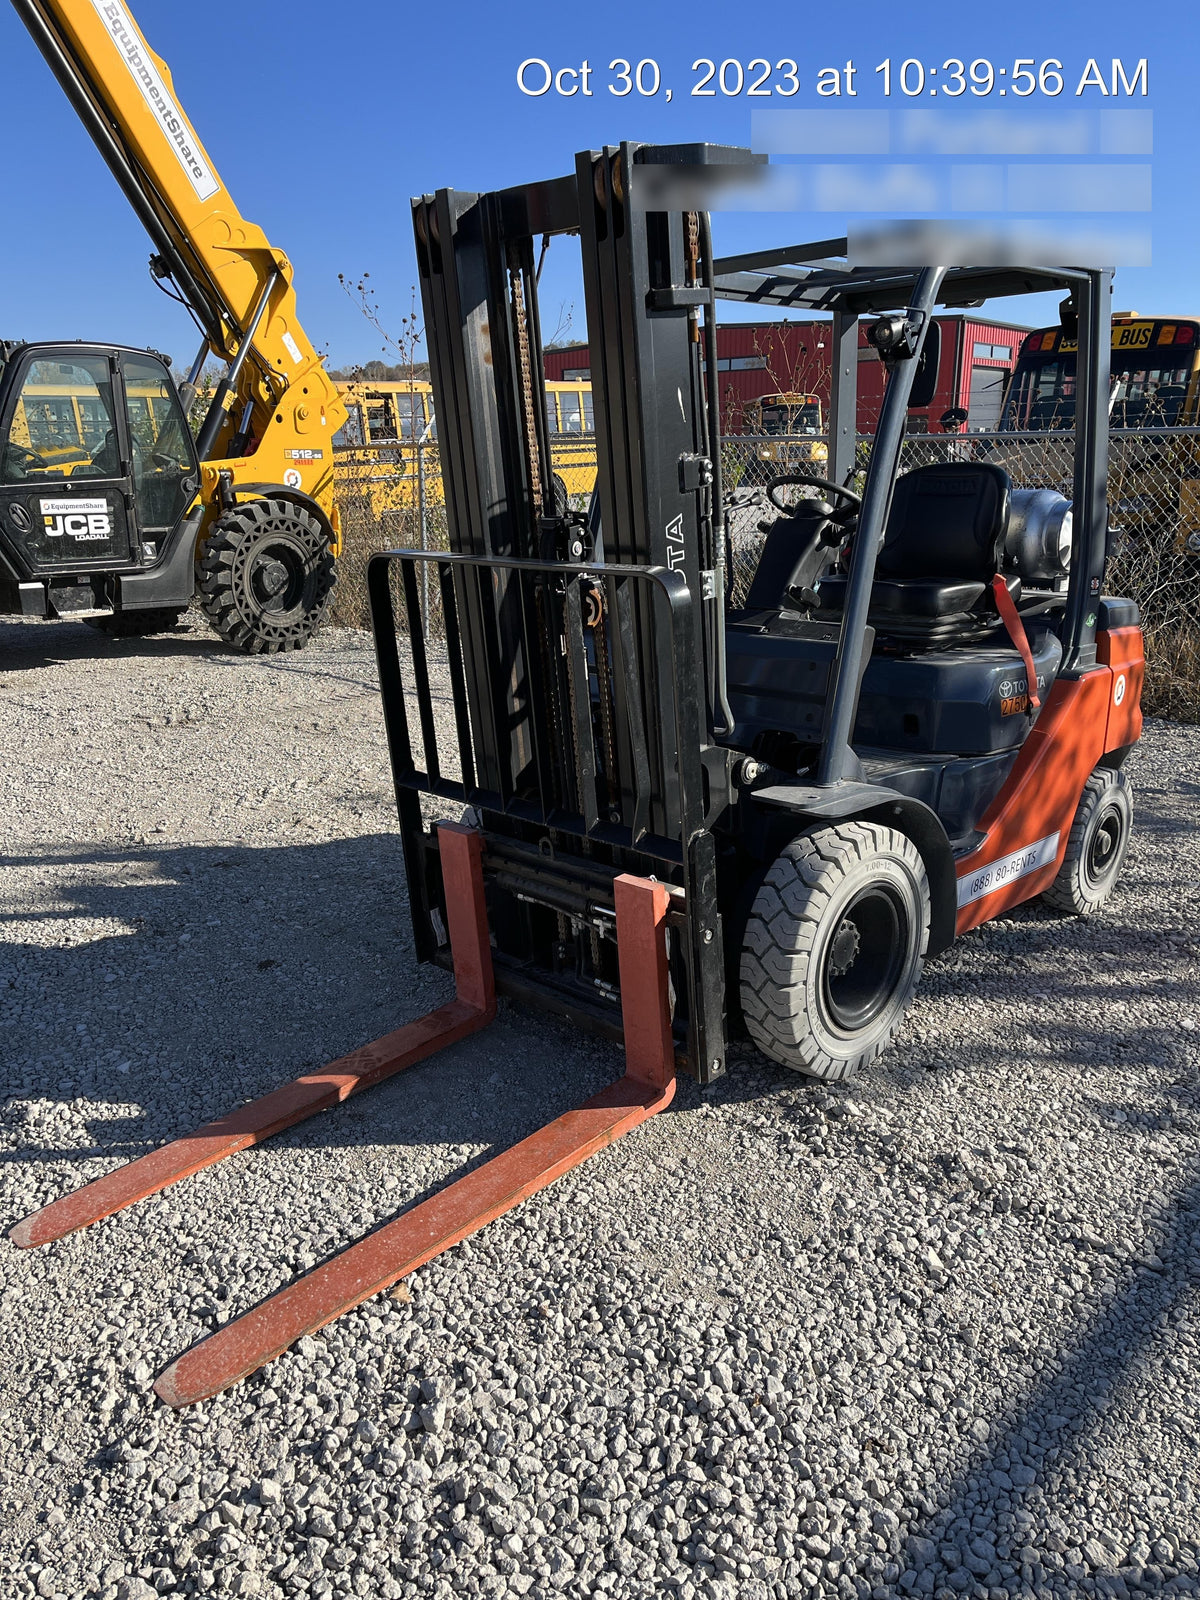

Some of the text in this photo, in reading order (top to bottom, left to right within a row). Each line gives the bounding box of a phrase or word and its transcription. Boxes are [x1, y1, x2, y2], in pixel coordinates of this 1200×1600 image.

[103, 2, 203, 179] EquipmentShare
[1119, 327, 1152, 346] BUS
[51, 503, 104, 511] EquipmentShare
[44, 514, 111, 537] JCB
[74, 533, 110, 541] LOADALL
[1013, 675, 1046, 694] TOTA
[970, 850, 1037, 896] (888) 80-RENTS
